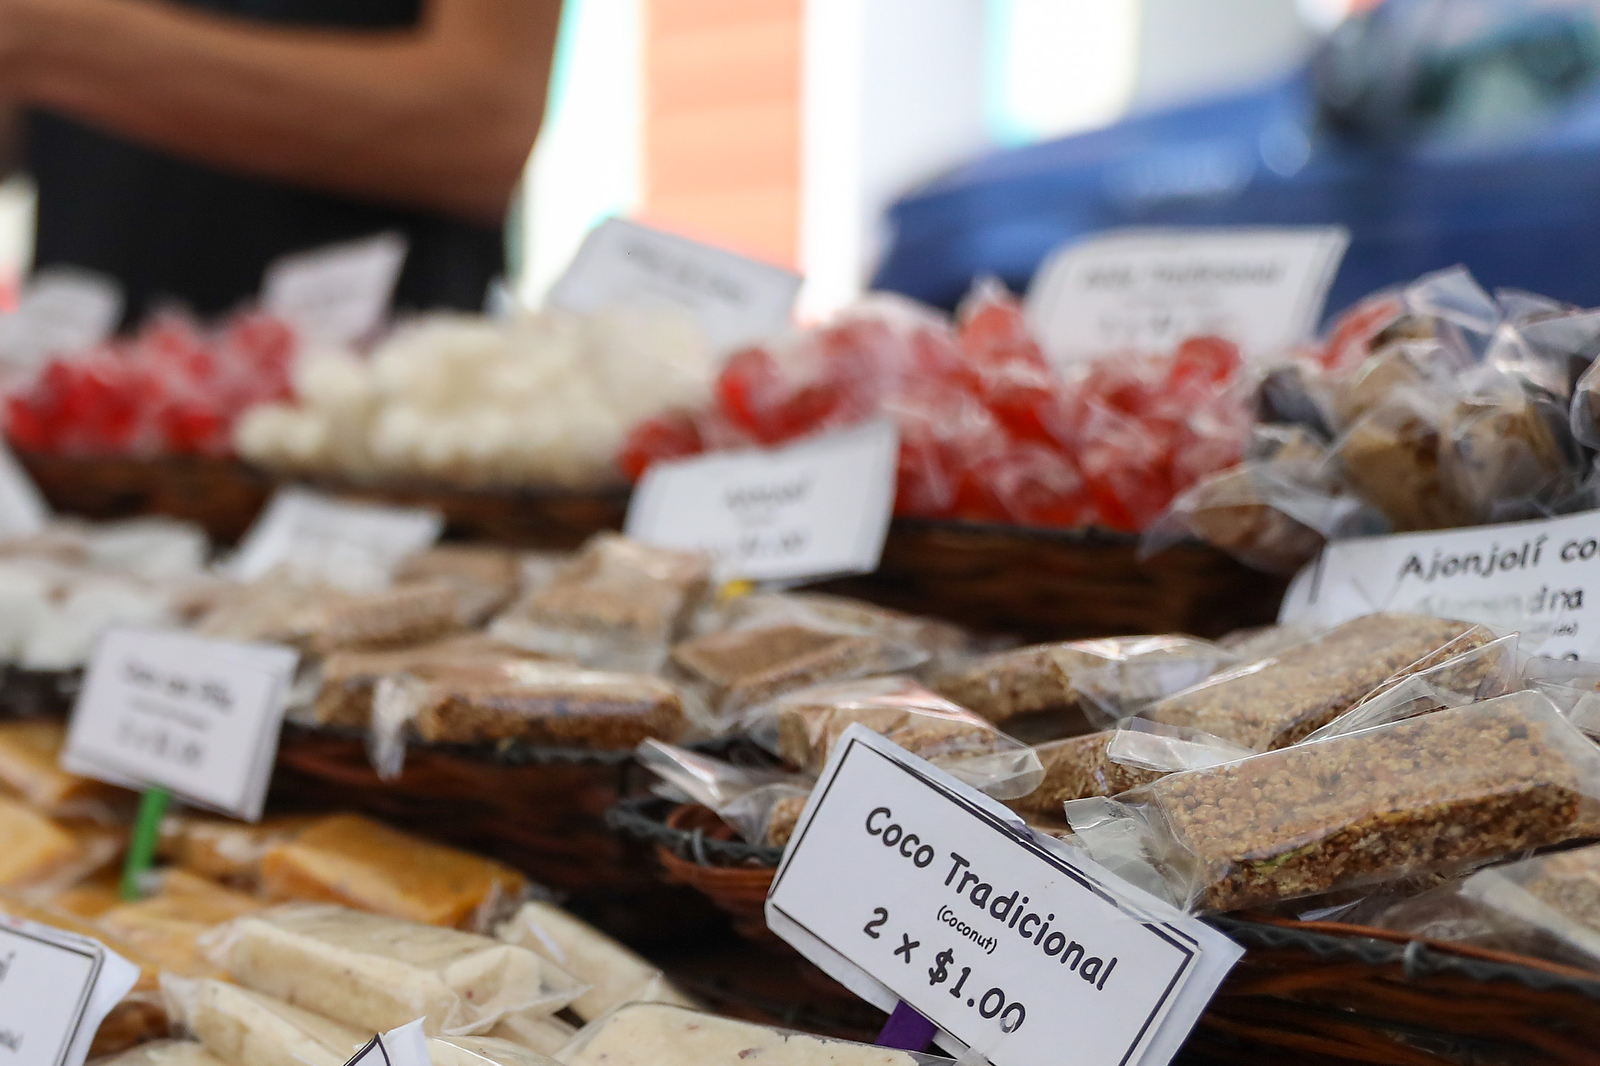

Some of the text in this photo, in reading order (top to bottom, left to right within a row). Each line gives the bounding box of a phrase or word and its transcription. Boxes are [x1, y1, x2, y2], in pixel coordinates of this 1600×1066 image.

[1399, 533, 1600, 582] Ajonjolí co
[865, 806, 1118, 991] Coco Tradicional
[936, 905, 998, 955] (Coconut)
[863, 907, 1027, 1034] 2 x $1.00
